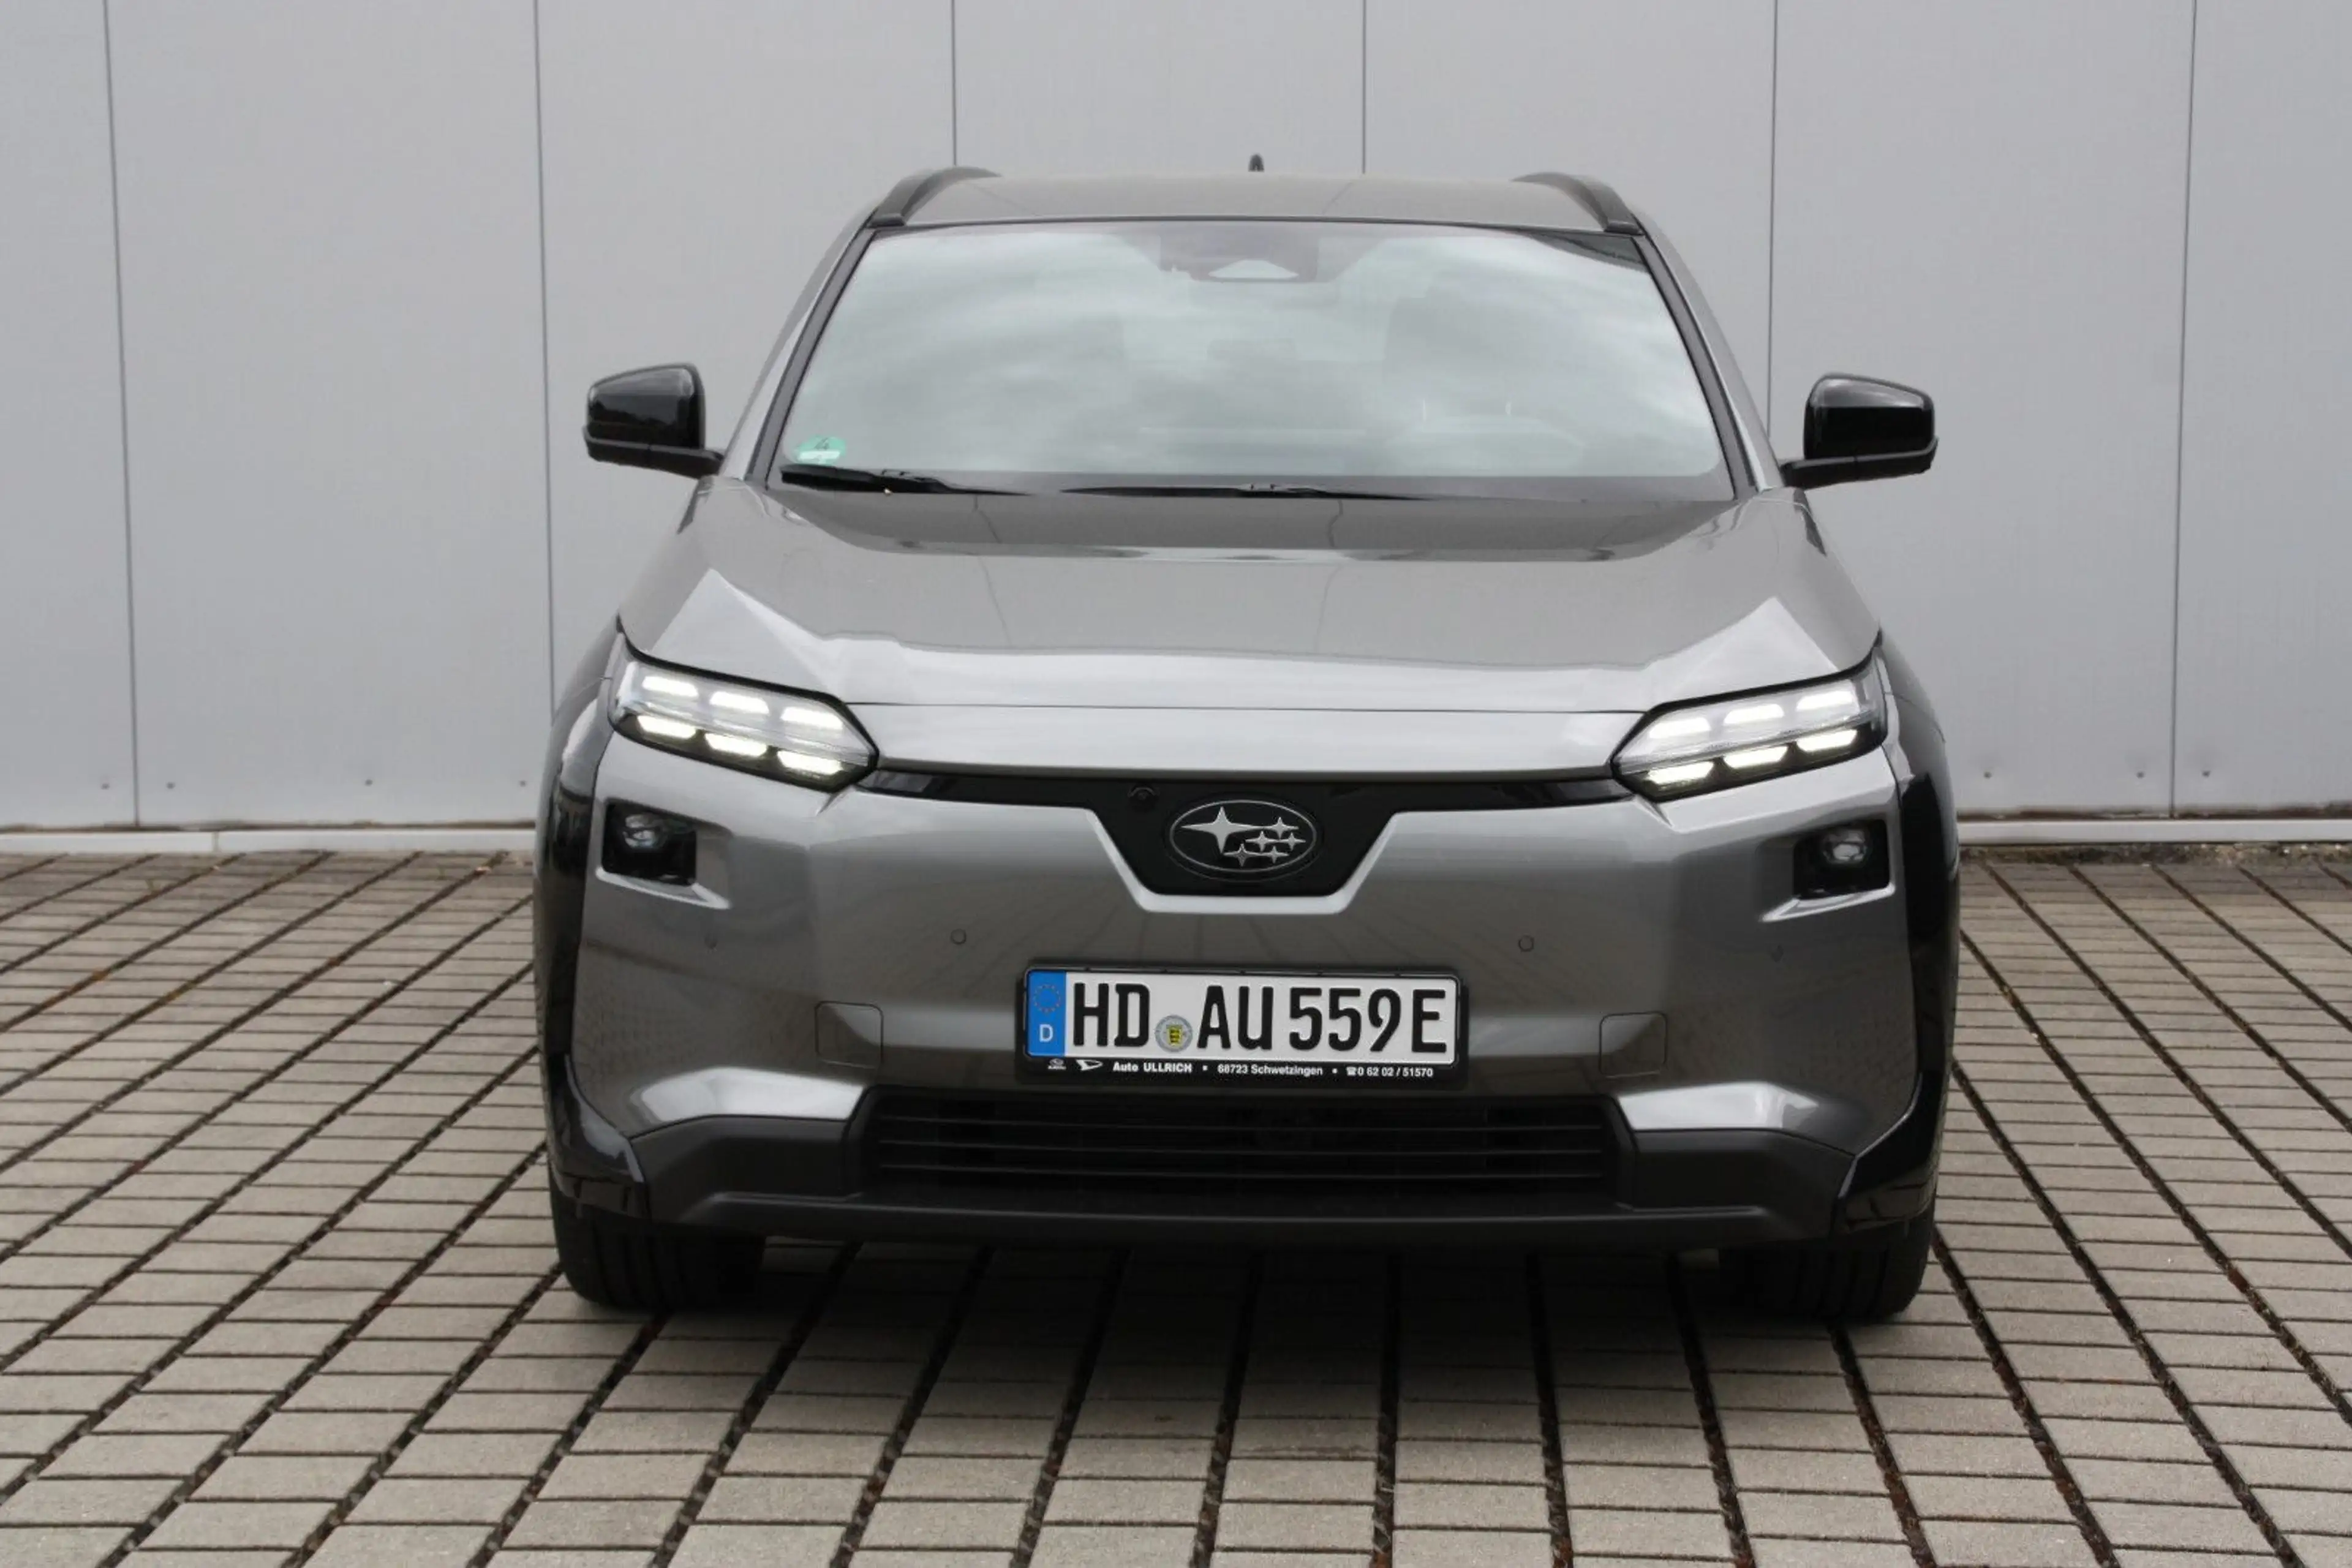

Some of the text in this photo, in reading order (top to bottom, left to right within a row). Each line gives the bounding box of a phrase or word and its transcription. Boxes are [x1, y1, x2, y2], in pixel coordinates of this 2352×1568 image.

[1073, 982, 1447, 1053] HD AU 559E
[1039, 1024, 1054, 1042] D
[1112, 1061, 1139, 1072] Auto
[1143, 1062, 1193, 1073] ULLRICH
[1218, 1064, 1248, 1074] 68723
[1251, 1064, 1323, 1077] Schwetzingen
[1402, 1068, 1434, 1077] 51570
